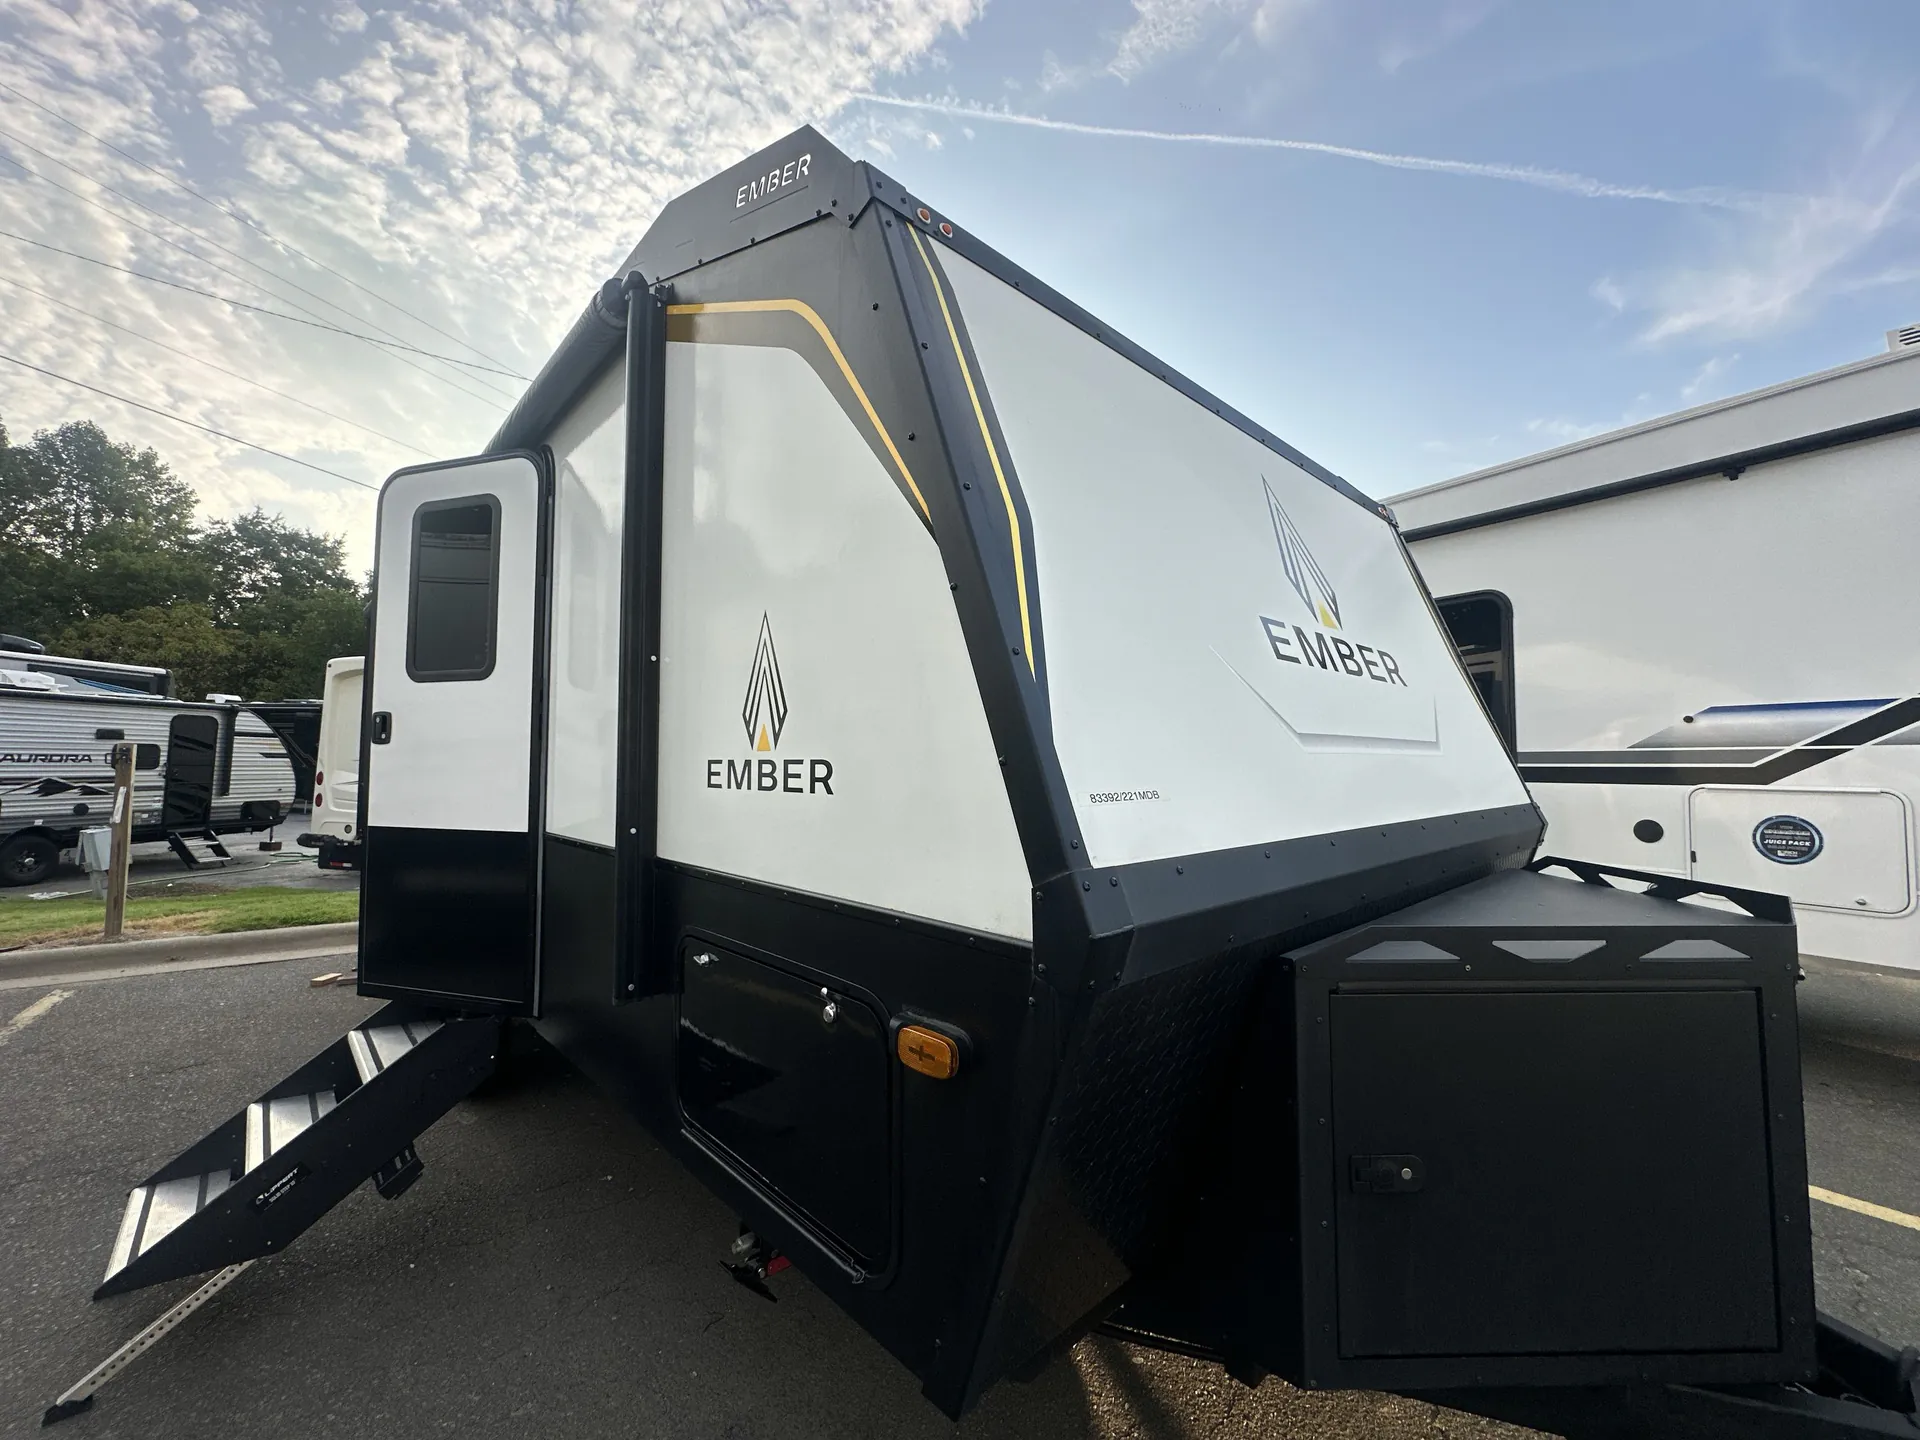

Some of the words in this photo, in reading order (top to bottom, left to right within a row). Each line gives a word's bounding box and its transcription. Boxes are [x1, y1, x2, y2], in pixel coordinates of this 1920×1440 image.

[735, 153, 811, 208] EMBER
[1259, 615, 1408, 687] EMBER
[0, 753, 92, 763] AURORA
[707, 759, 834, 795] EMBER
[1089, 790, 1160, 804] 83392/221MDB
